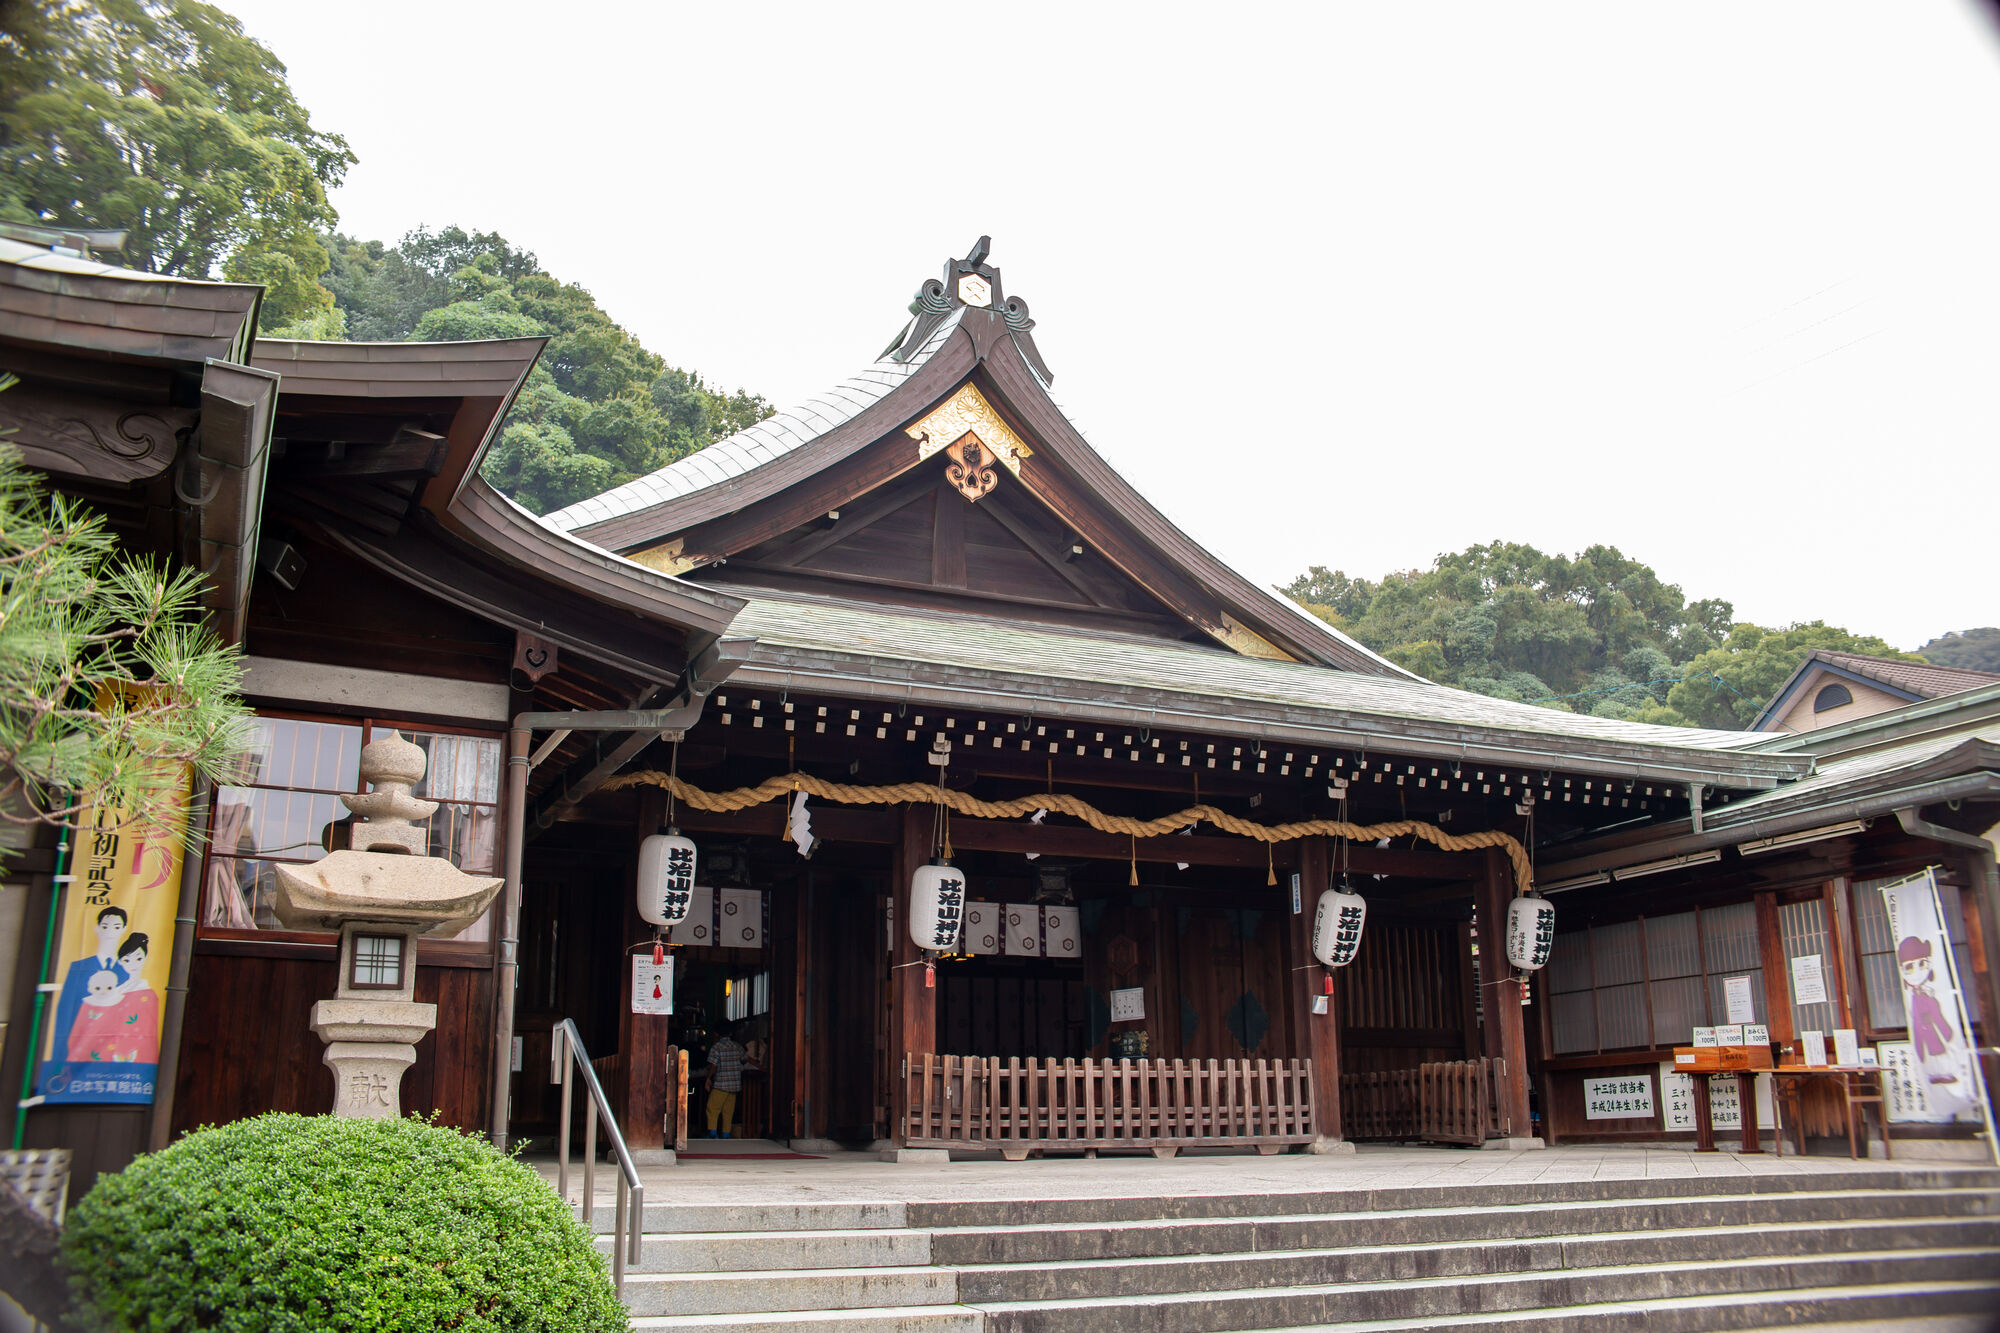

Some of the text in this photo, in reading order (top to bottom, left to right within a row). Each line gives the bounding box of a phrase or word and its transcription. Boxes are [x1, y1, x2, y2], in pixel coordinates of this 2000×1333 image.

[661, 847, 694, 920] 比治山神社
[932, 878, 962, 946] 比治山神社
[1330, 905, 1362, 964] 比治山神社
[1531, 908, 1554, 965] 比治山神社
[1591, 1098, 1652, 1112] 平成24年生(男女)
[1619, 1080, 1645, 1094] 該当者
